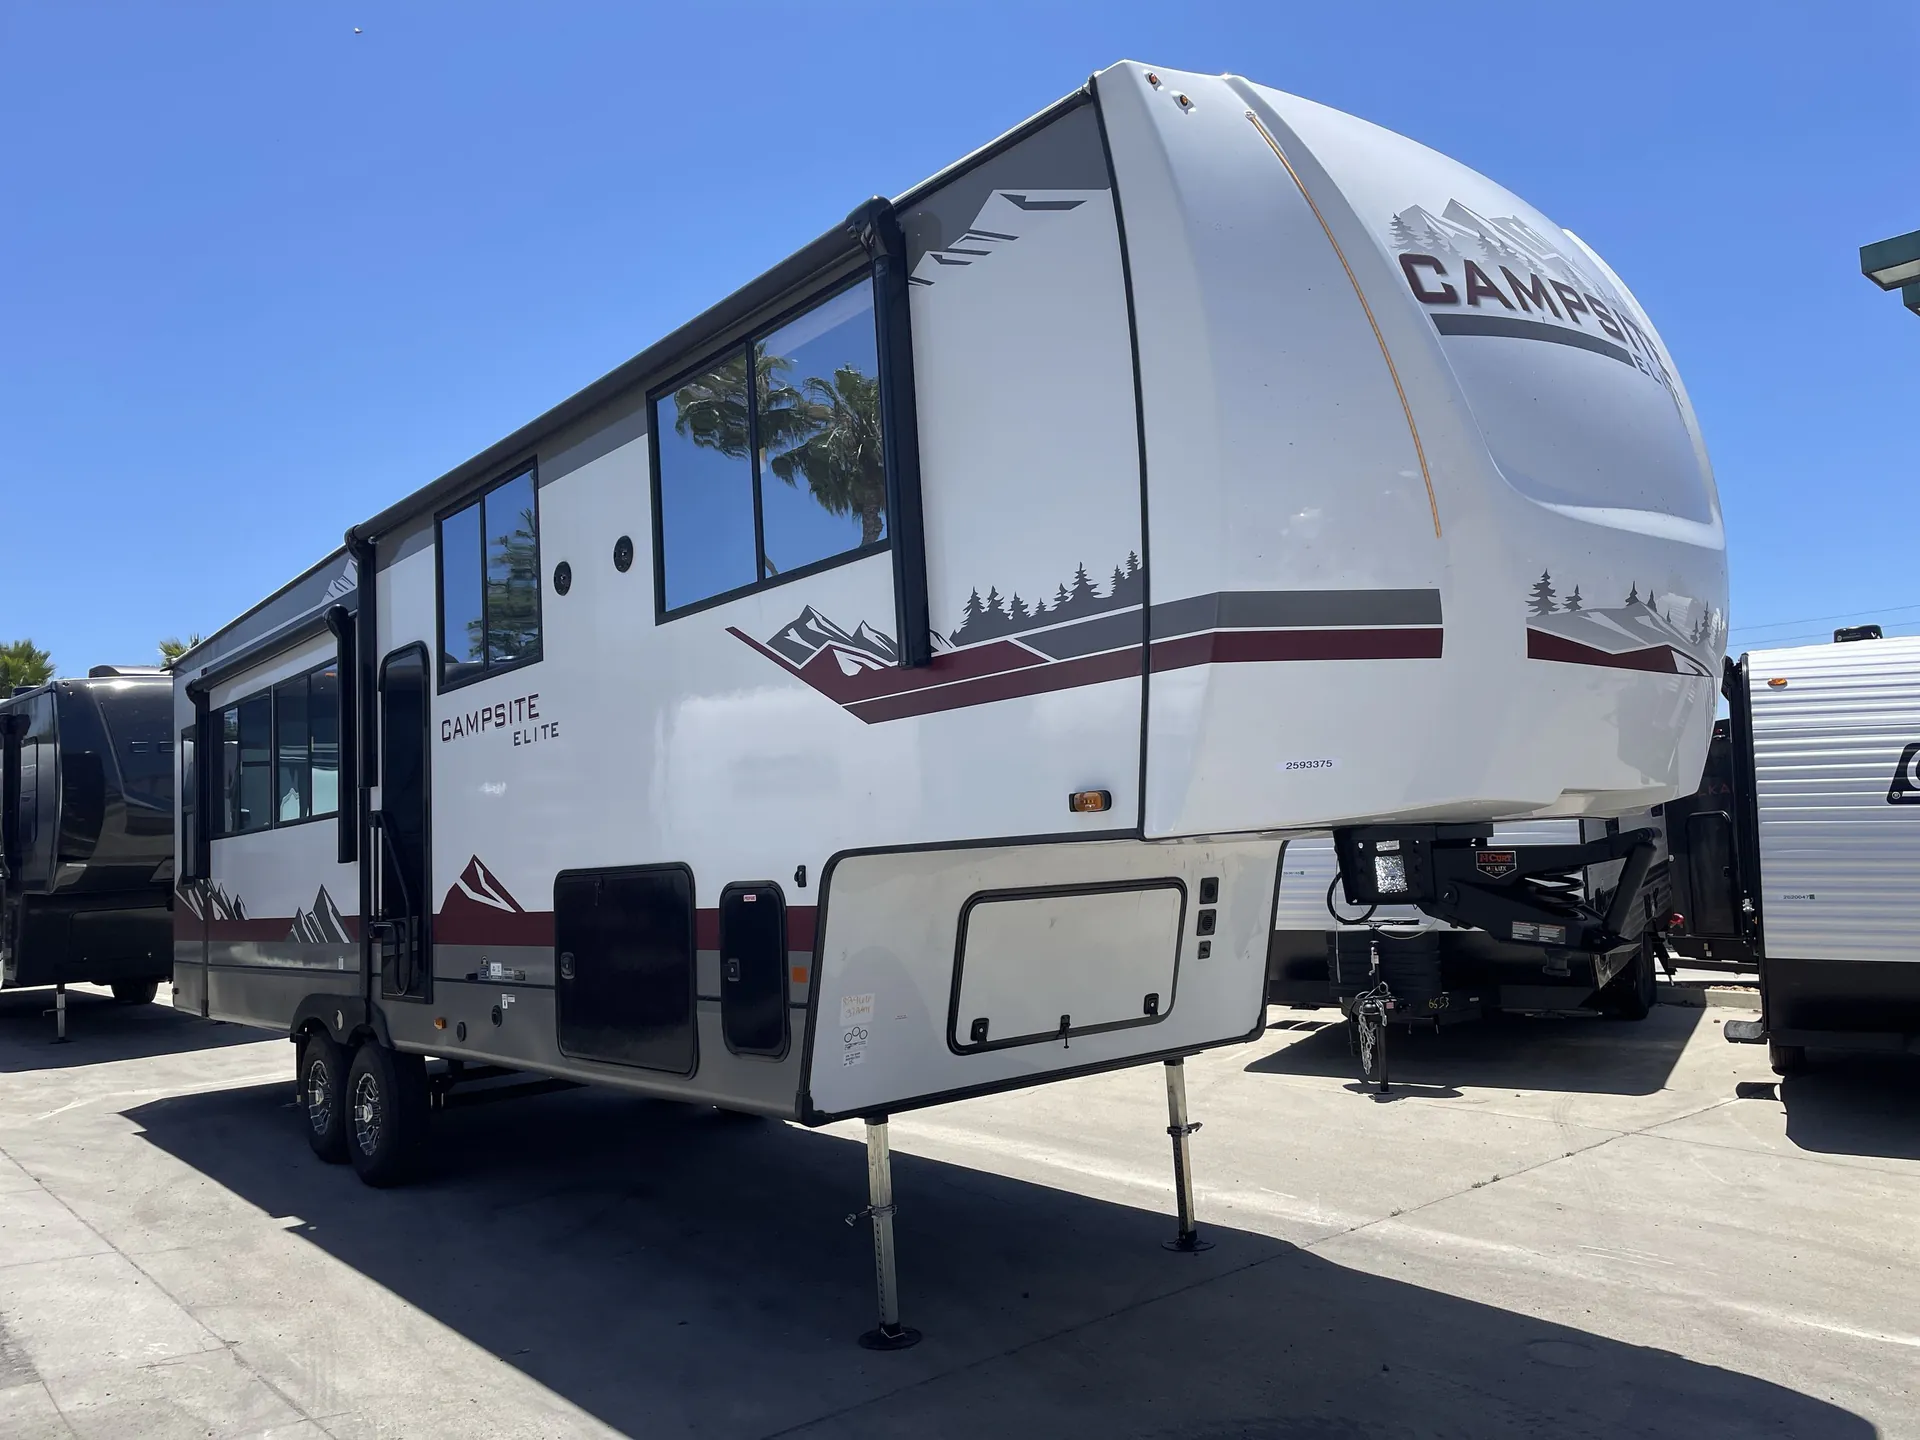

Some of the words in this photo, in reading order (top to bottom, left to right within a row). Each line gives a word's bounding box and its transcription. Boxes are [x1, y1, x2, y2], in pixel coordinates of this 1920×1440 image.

[441, 693, 540, 742] CAMPSITE
[513, 721, 560, 747] ELITE
[1285, 759, 1333, 770] 2593375
[1428, 996, 1450, 1009] 6653
